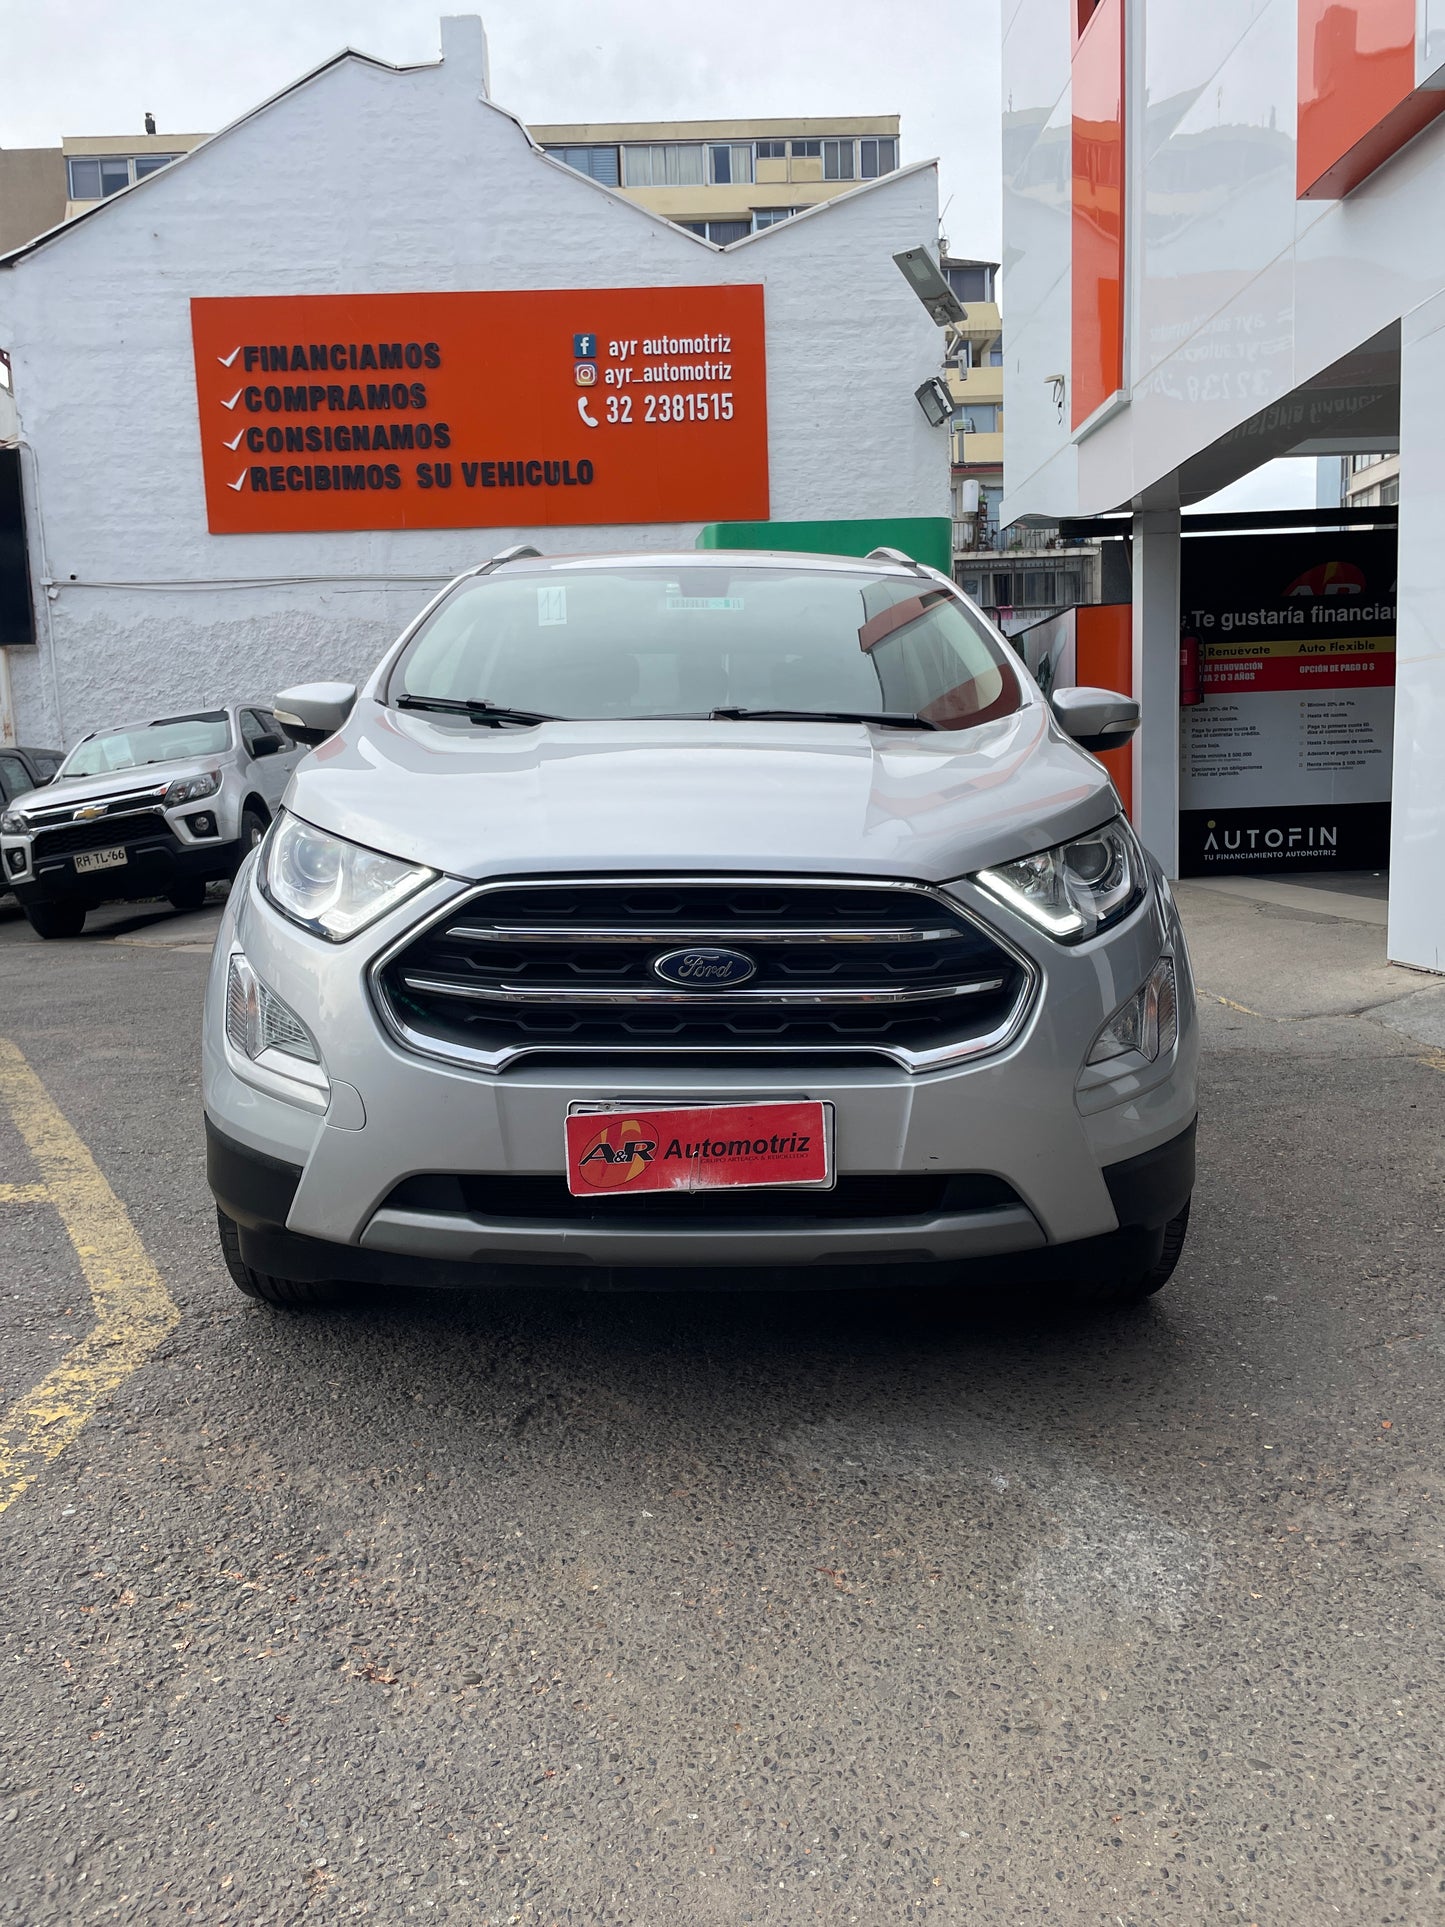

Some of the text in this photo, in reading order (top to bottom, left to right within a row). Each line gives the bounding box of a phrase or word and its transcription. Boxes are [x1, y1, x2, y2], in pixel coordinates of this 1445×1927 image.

[243, 342, 441, 372] FINANCIAMOS
[608, 334, 731, 361] ayr automotriz
[604, 361, 732, 389] ayr_automotriz
[244, 383, 427, 412] COMPRAMOS
[606, 392, 734, 423] 32 2381515
[246, 423, 451, 453] CONSIGNAMOS
[250, 459, 594, 492] RECIBIMOS SU VEHICULO
[1221, 606, 1304, 631] gustaría
[1298, 641, 1375, 653] Auto Flexible
[1214, 661, 1263, 672] RENOVACIÓN
[1234, 671, 1256, 681] AÑOS
[1299, 663, 1328, 674] OPCIÓN
[1329, 664, 1340, 672] DE
[1340, 663, 1361, 672] PAGO
[1203, 826, 1337, 851] AUTOFIN
[1216, 851, 1284, 861] FINANCIAMIENTO
[1285, 849, 1337, 858] AUTOMOTRIZ
[677, 954, 733, 978] Ford
[578, 1132, 810, 1167] A&R Automotriz
